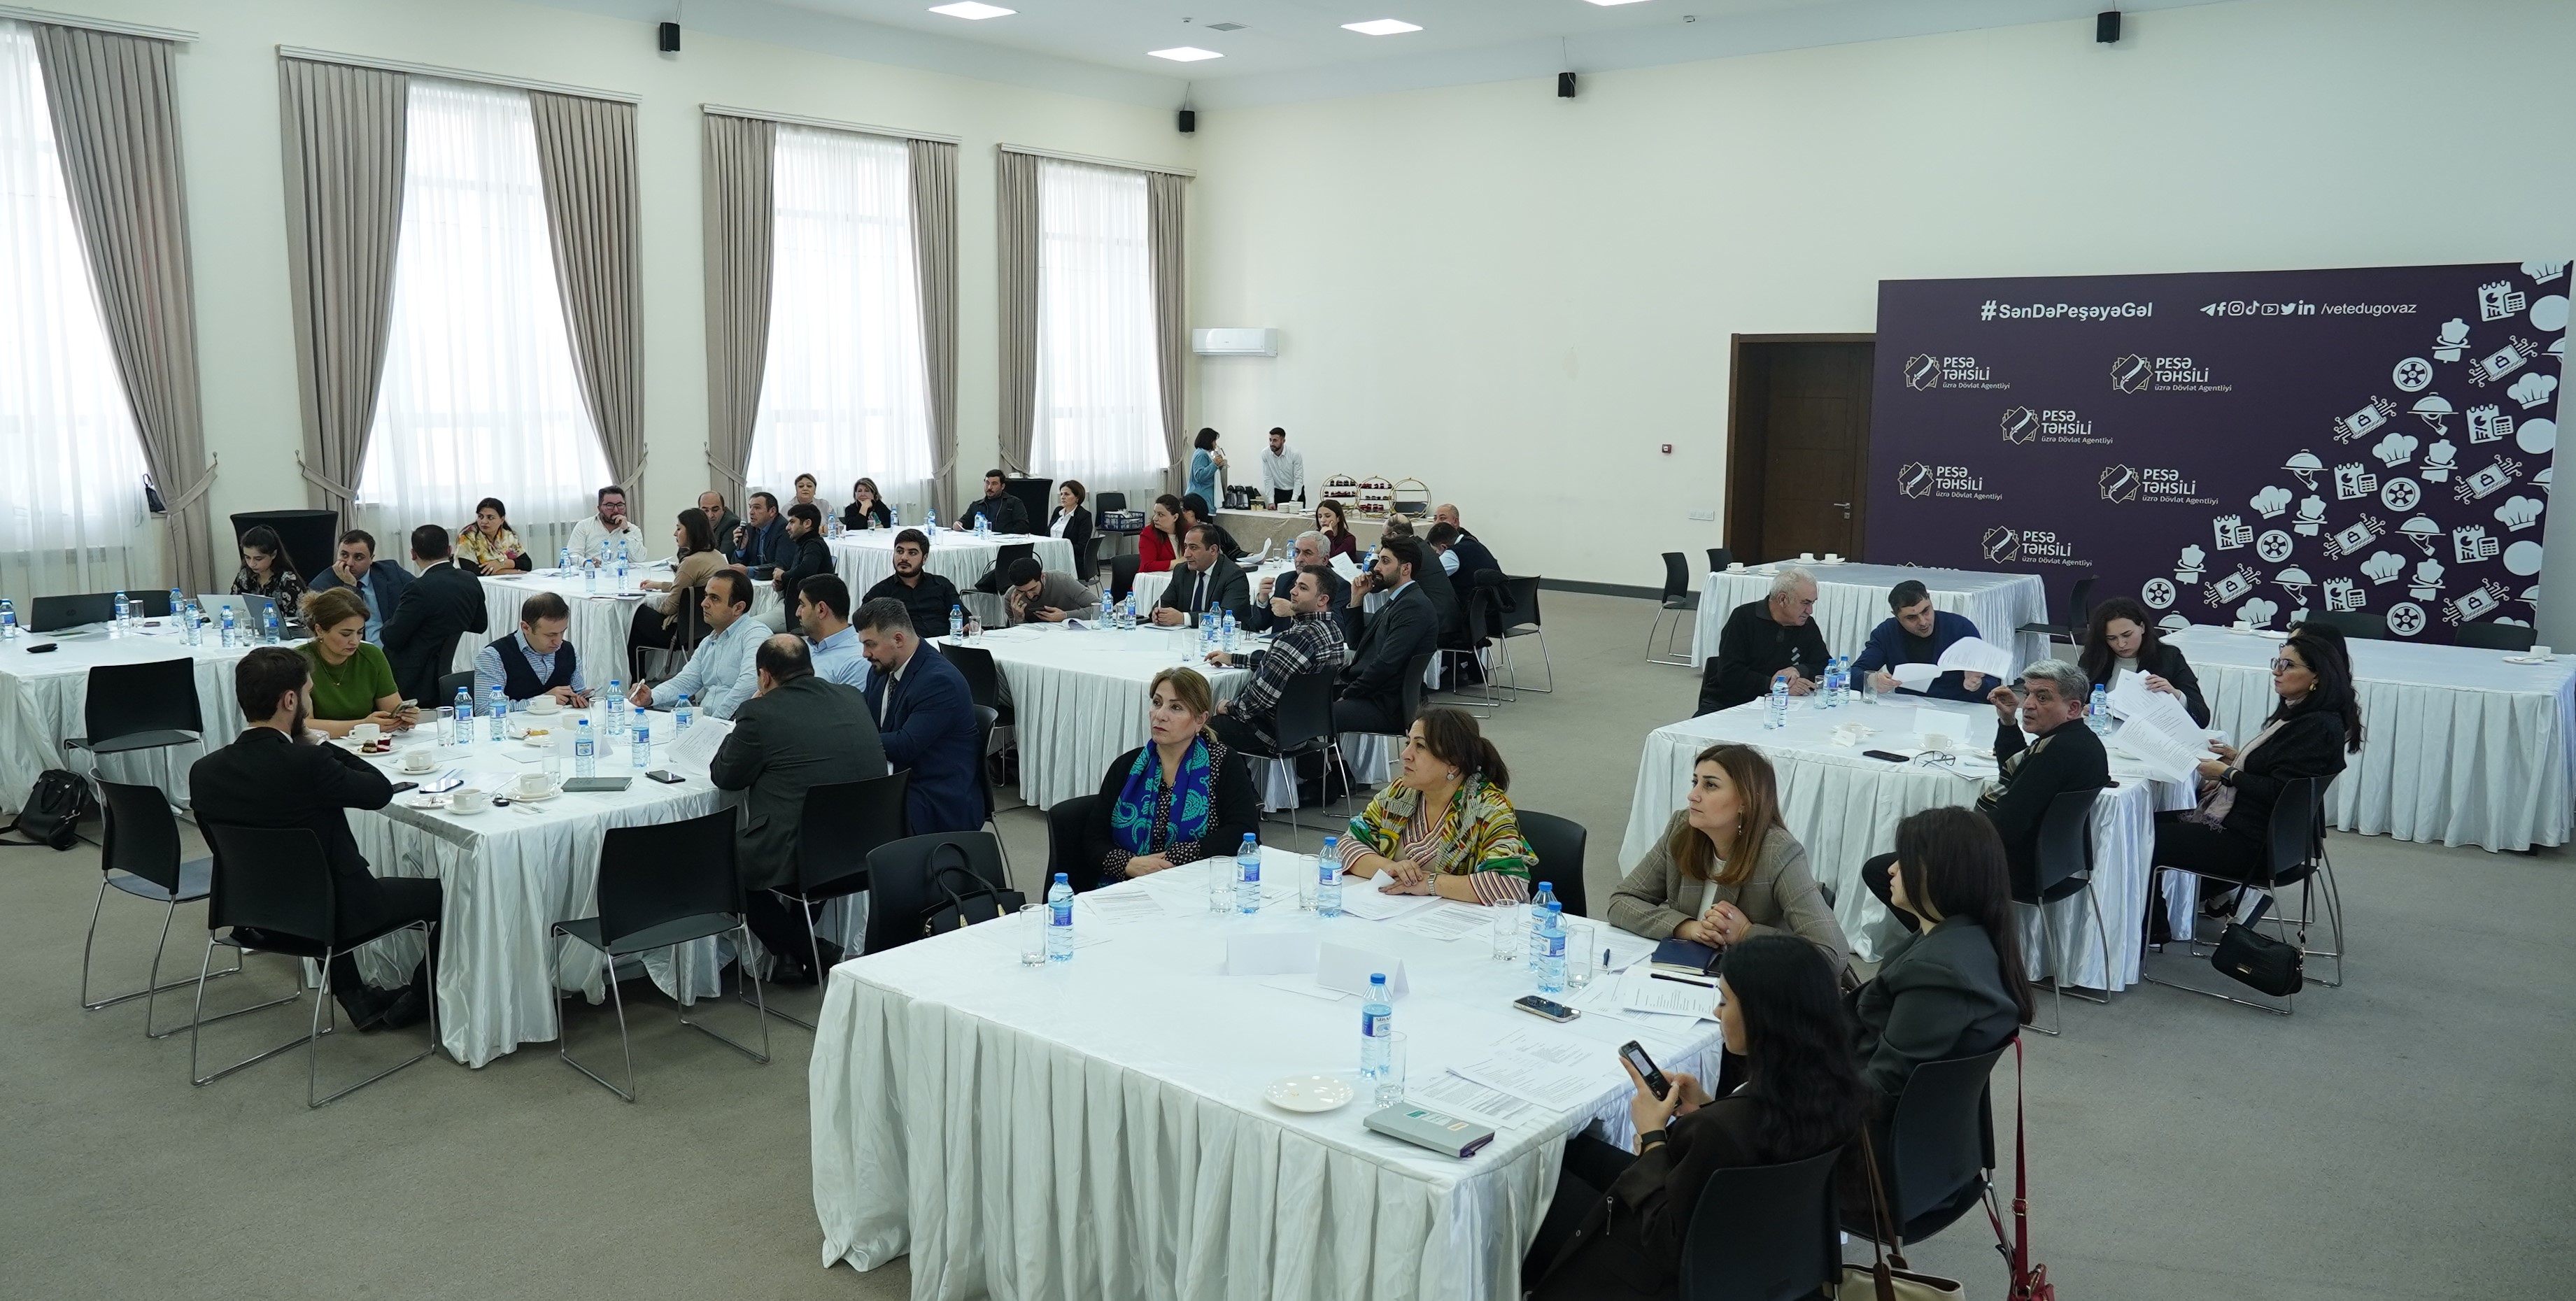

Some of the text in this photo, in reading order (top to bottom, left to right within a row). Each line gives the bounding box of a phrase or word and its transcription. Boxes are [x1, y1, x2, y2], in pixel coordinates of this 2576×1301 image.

[1981, 299, 2153, 321] #SənDəPeşəyəGəl
[2321, 303, 2417, 317] /vetedugovaz
[1942, 367, 1990, 381] TƏHSİLİ
[2154, 367, 2209, 382] TƏHSİLİ
[2041, 420, 2092, 434] TƏHSİLİ
[1935, 476, 1983, 490] TƏHSİLİ
[2142, 479, 2196, 495] TƏHSİLİ
[1974, 492, 2002, 501] Agentliyi
[2185, 497, 2218, 506] Agentliyi
[2022, 542, 2072, 556] TƏHSİLİ
[2062, 559, 2093, 567] Agentliyi
